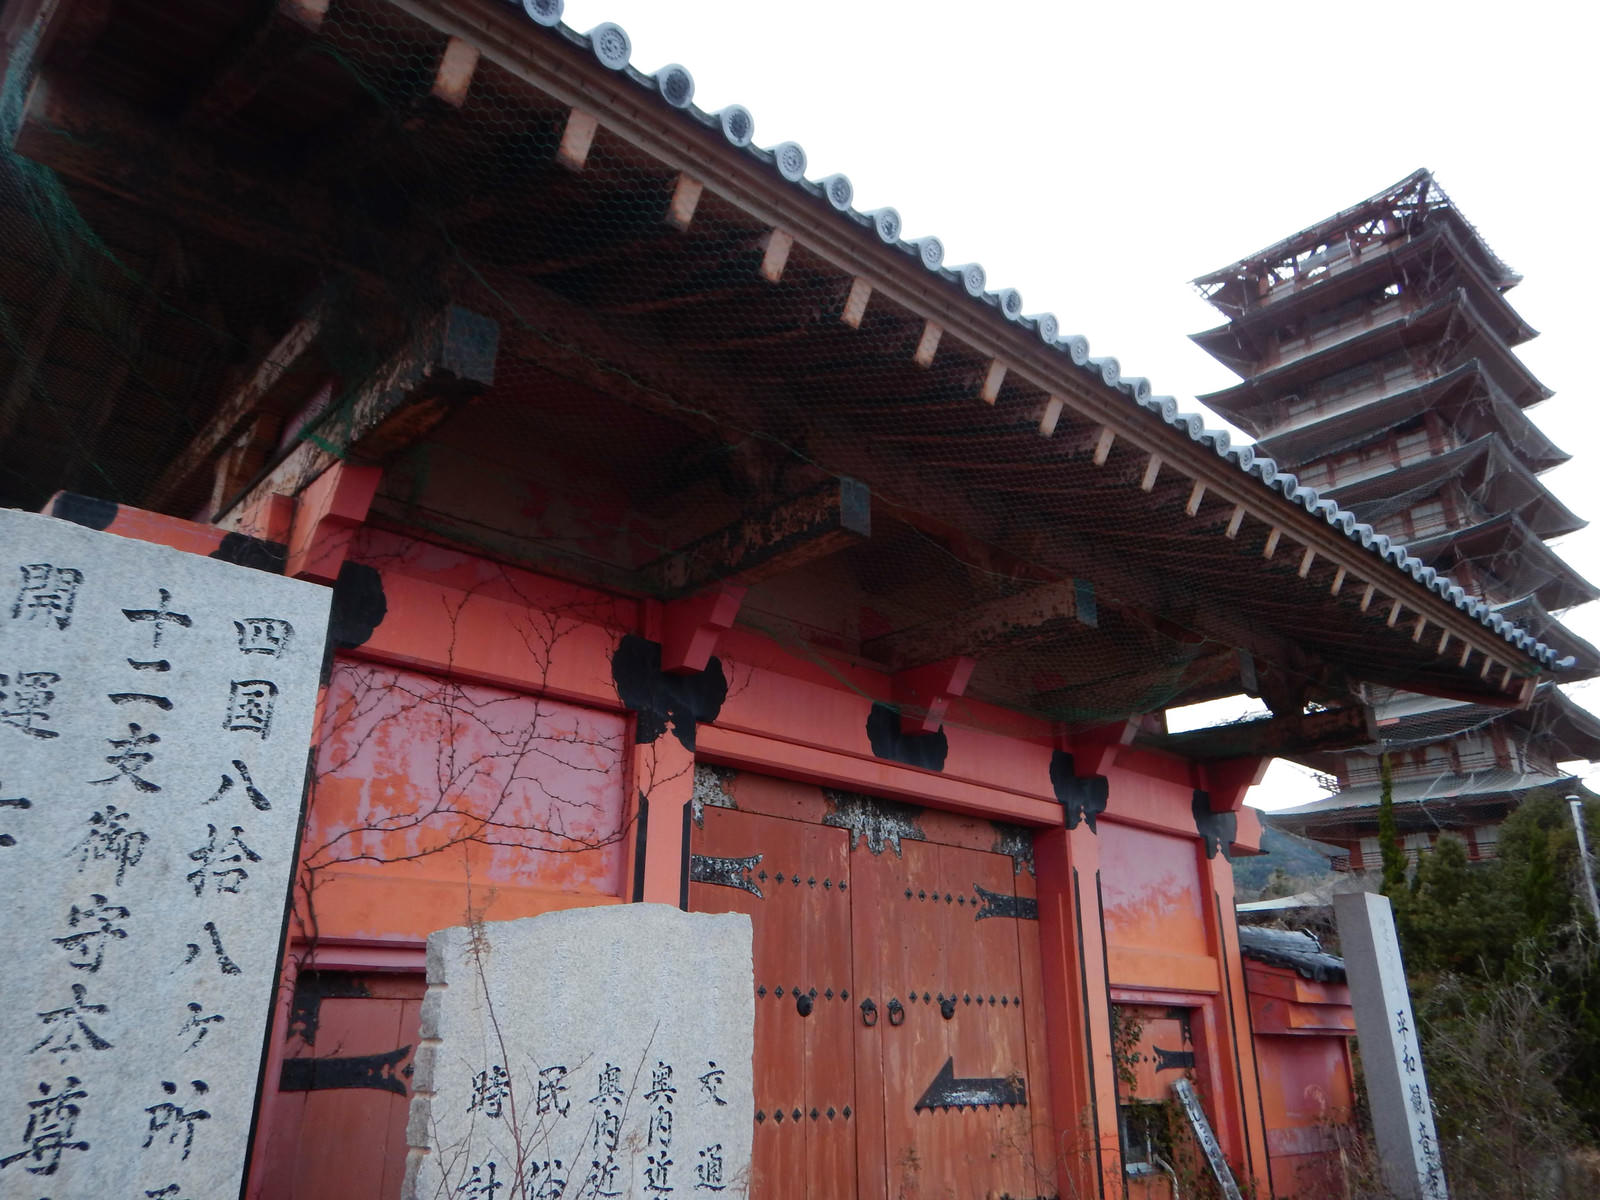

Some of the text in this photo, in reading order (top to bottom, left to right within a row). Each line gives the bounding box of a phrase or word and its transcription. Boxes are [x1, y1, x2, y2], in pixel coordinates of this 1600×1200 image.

[0, 563, 84, 846] 開運
[0, 588, 192, 1200] 十二支御守本尊
[643, 1061, 678, 1200] 奥内近
[695, 1061, 728, 1191] 交通
